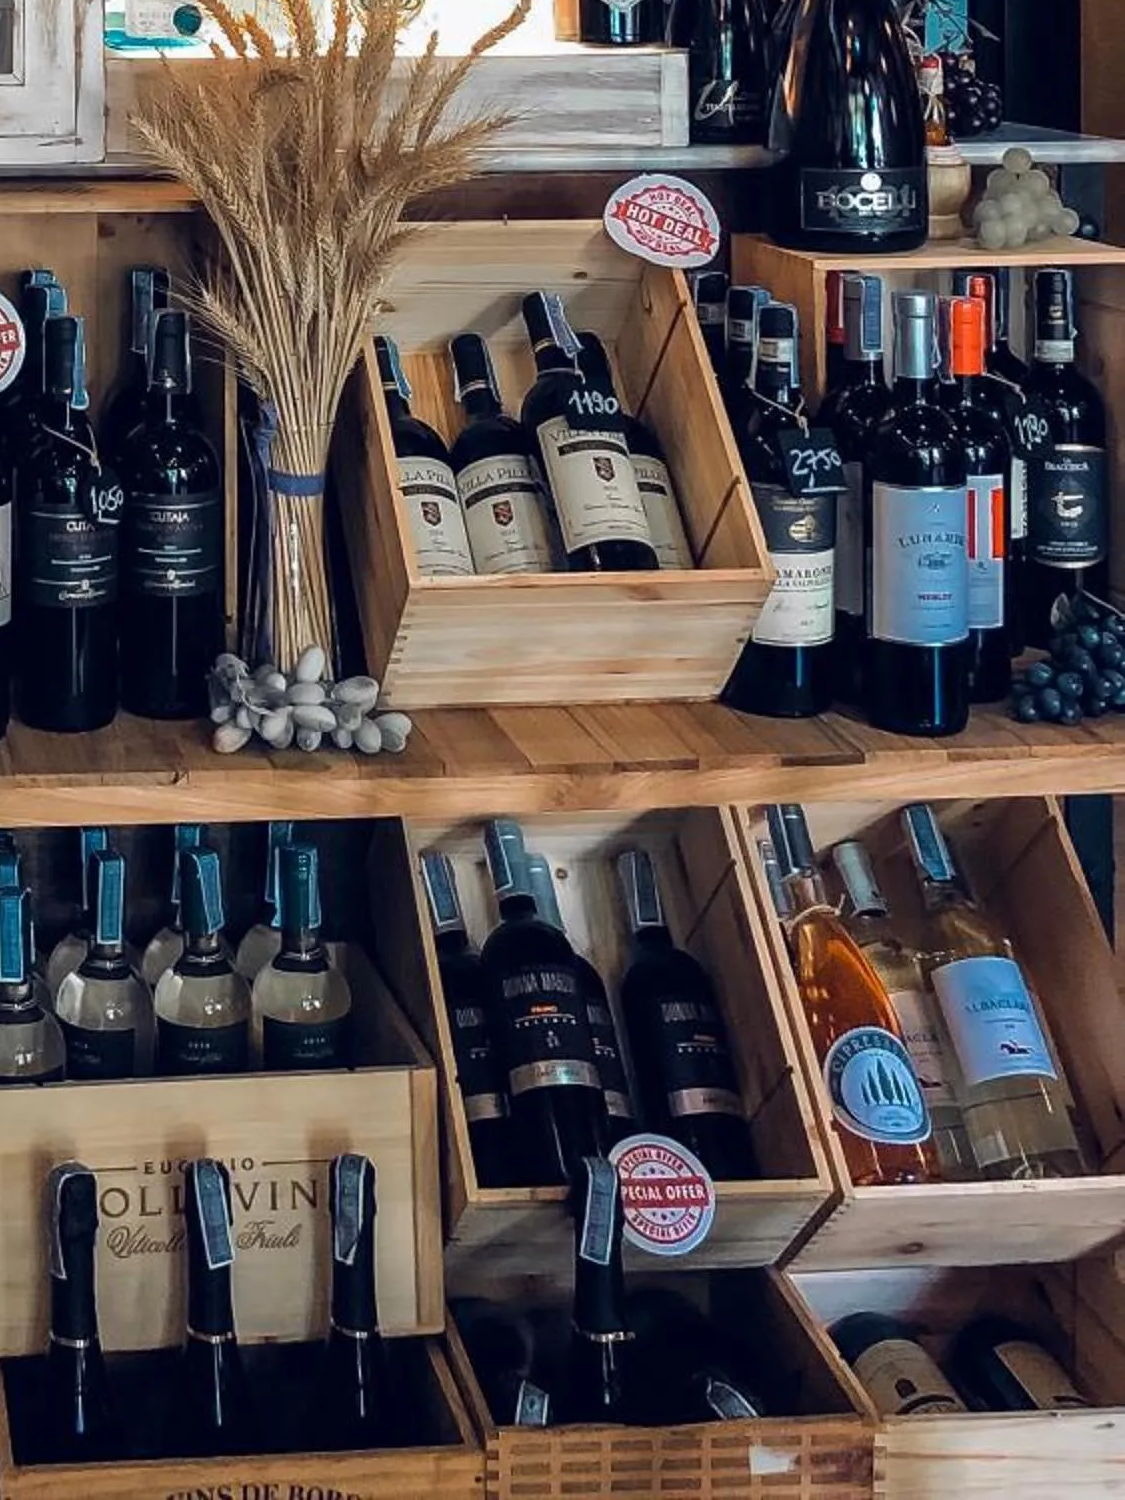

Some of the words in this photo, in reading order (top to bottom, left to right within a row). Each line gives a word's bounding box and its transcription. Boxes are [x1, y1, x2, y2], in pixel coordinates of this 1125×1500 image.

[626, 202, 661, 227] HOT
[663, 216, 704, 245] DEAL
[621, 1185, 664, 1202] PECIAL
[665, 1183, 706, 1200] OFFER
